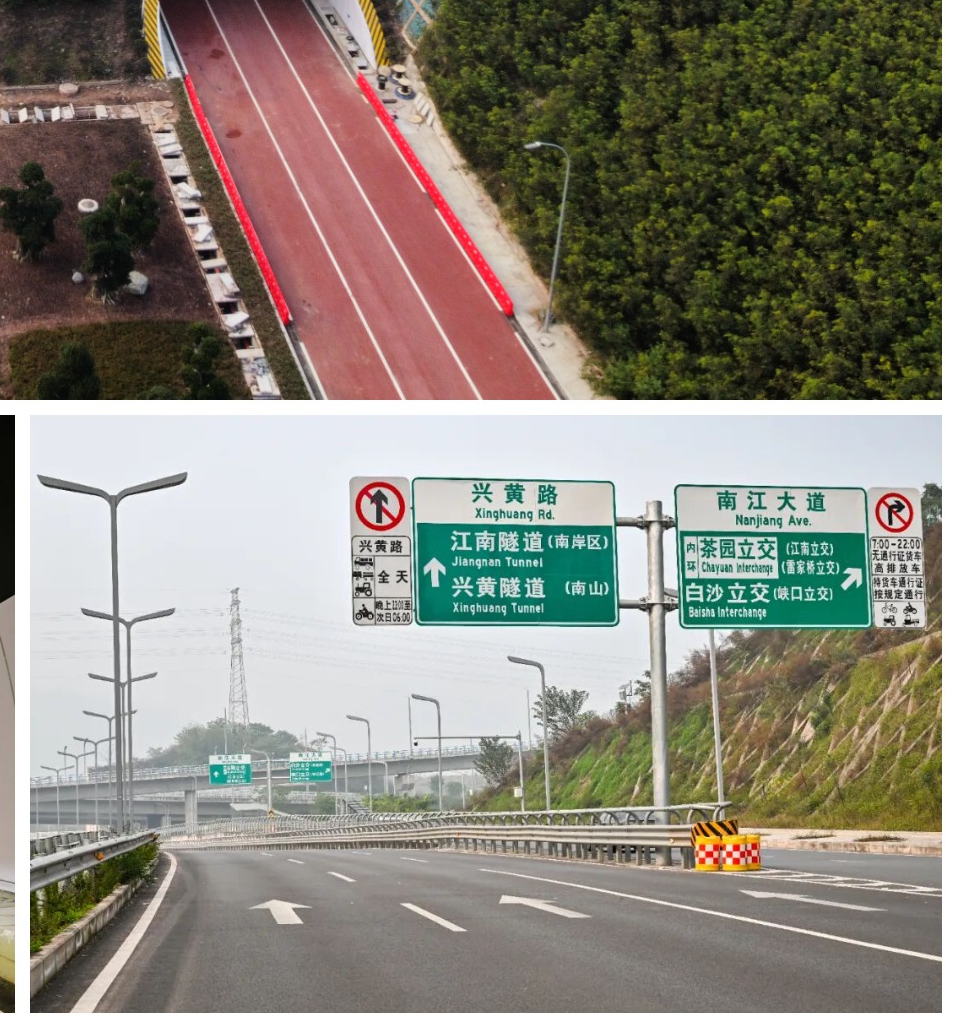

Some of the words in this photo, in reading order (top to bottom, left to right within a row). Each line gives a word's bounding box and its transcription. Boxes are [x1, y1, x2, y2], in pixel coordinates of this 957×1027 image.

[471, 483, 558, 506] 兴黄路
[717, 490, 826, 512] 南江大道
[475, 508, 533, 521] Xinghuang
[538, 509, 555, 520] Rd.
[736, 514, 783, 528] Nanjiang
[788, 515, 812, 526] Ave.
[359, 540, 403, 553] 兴黄路
[451, 531, 544, 552] 江南隧道
[547, 534, 608, 549] (南岸区)
[700, 538, 776, 560] 茶园立交
[786, 542, 834, 556] (江南立交)
[872, 550, 922, 561] 无通行证货车
[452, 557, 501, 569] Jiangnan
[505, 557, 543, 568] Tunnel
[702, 562, 733, 574] Chayuan
[736, 562, 774, 576] Interchange
[875, 563, 920, 573] 高排放车
[378, 570, 408, 583] 全天
[452, 577, 545, 598] 兴黄隧道
[565, 581, 609, 596] (南山)
[686, 582, 771, 604] 白沙立交
[773, 586, 833, 601] (峡口立交)
[875, 589, 923, 599] 按规定通行
[453, 603, 507, 614] Xinghuang
[511, 604, 544, 614] Tunnel
[688, 606, 715, 618] Baisha
[718, 606, 767, 620] Interchange
